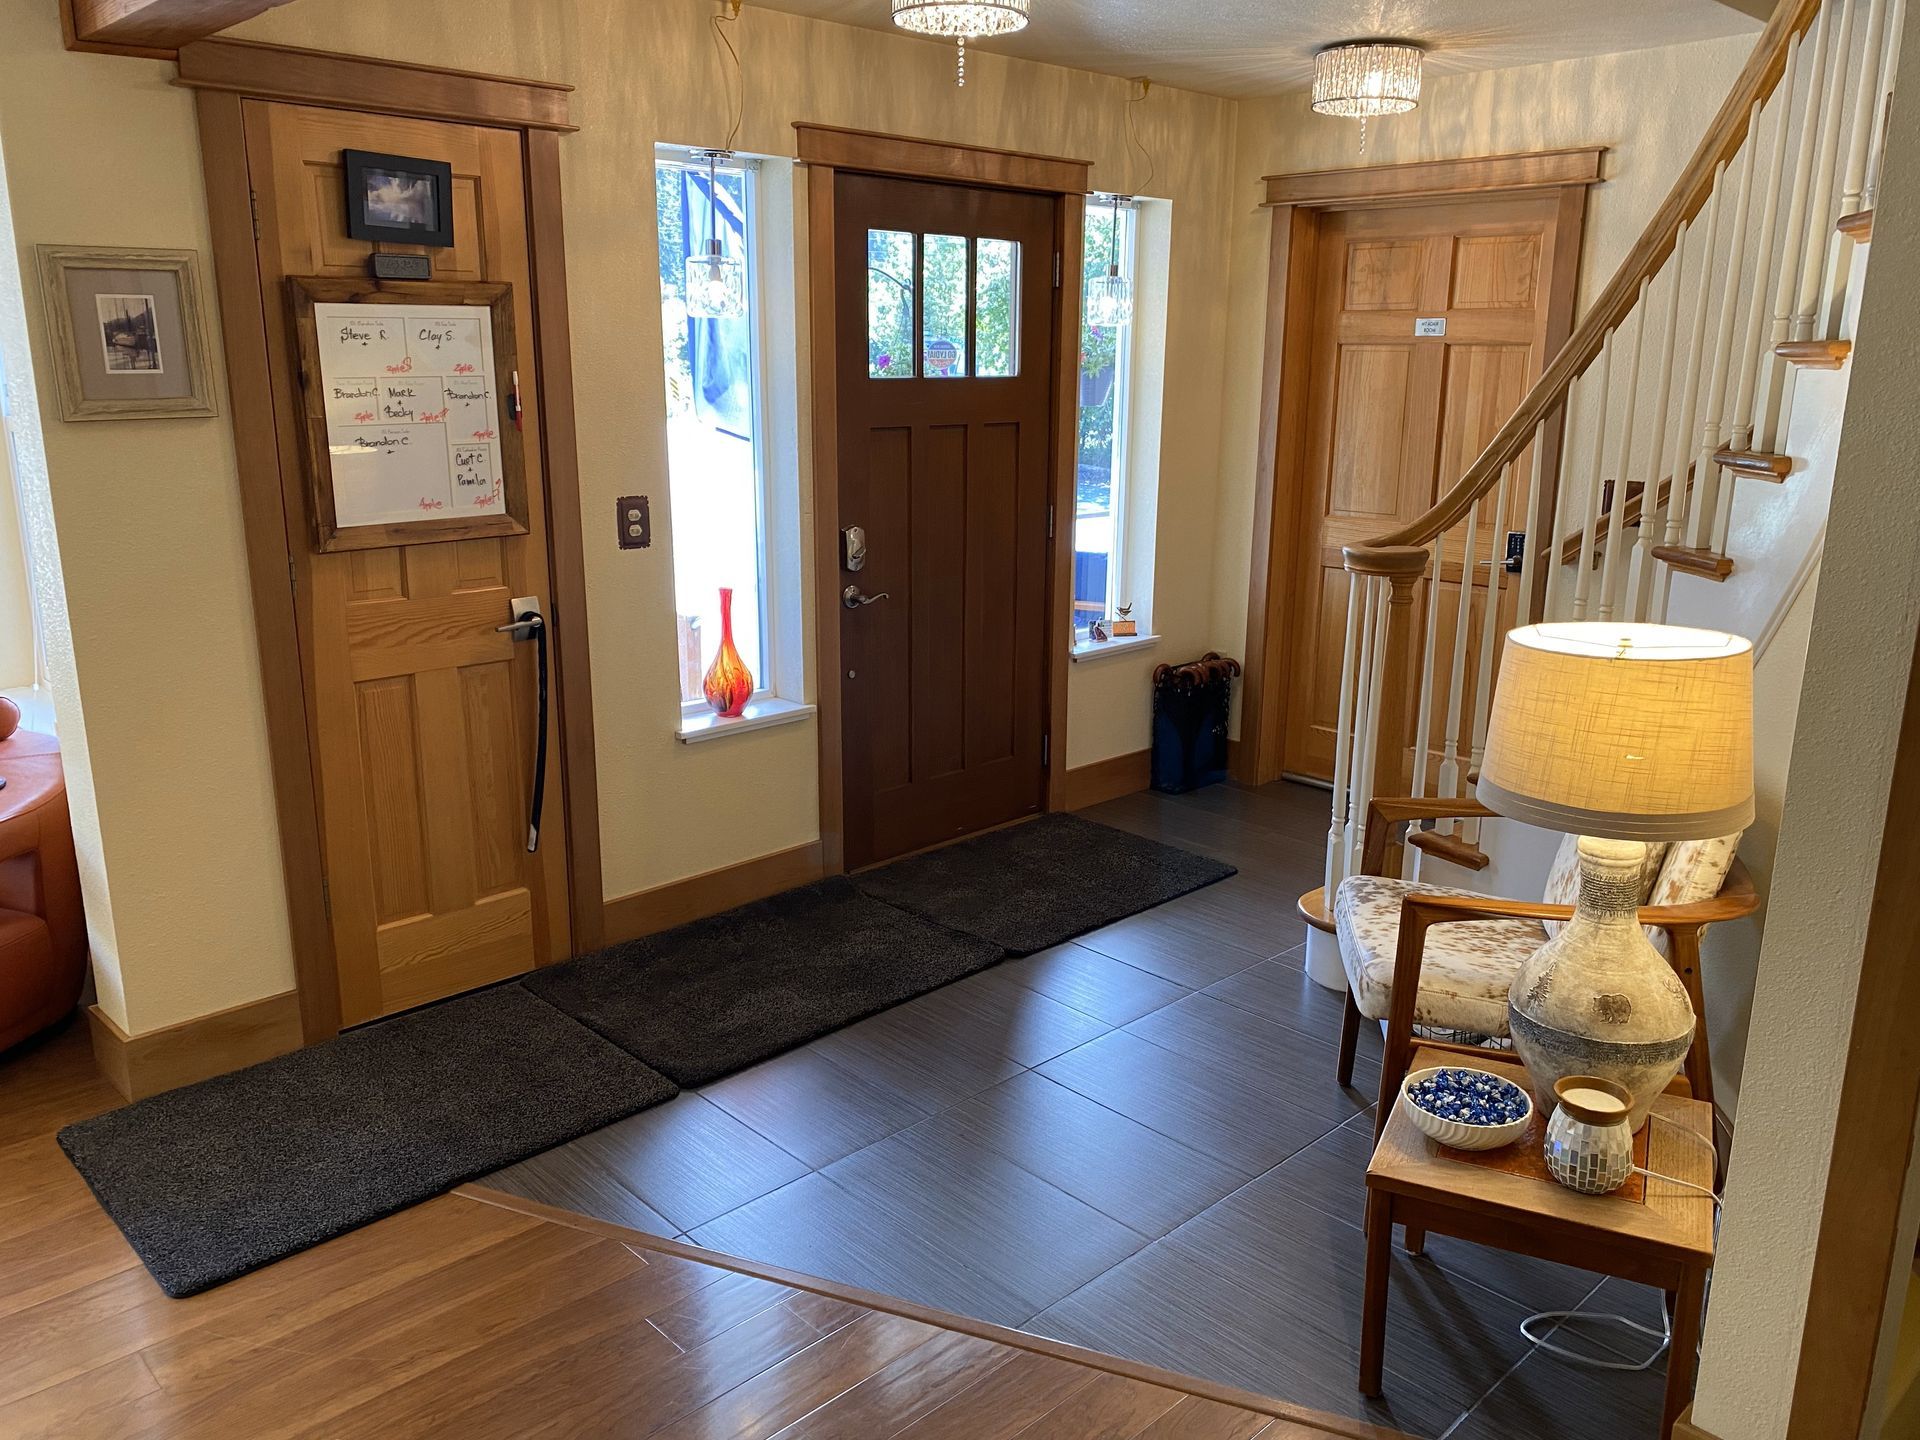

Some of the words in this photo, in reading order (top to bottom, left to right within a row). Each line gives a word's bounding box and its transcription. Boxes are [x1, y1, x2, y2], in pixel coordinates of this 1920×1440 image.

[340, 326, 371, 344] Steve
[419, 328, 442, 344] Clay
[333, 387, 372, 399] Brandon
[354, 436, 399, 448] Brandon
